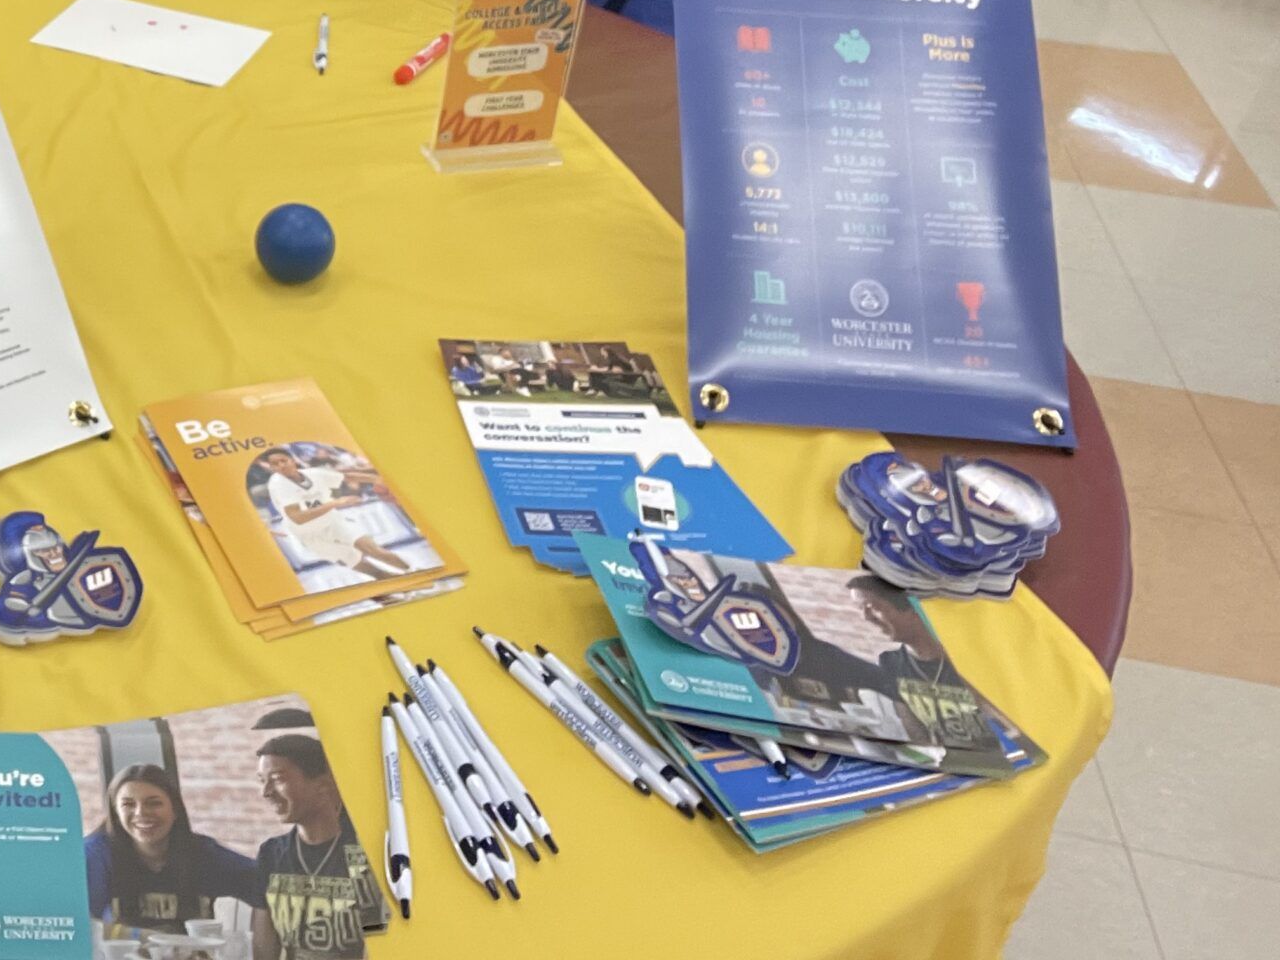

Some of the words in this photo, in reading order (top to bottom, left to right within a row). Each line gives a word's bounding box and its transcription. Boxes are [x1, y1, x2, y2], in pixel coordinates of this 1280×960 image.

[928, 49, 971, 63] More
[830, 318, 913, 335] WORCESTER
[743, 327, 801, 345] Housing
[831, 334, 913, 353] UNIVERSITY
[175, 419, 232, 445] Be
[479, 421, 521, 432] Want
[524, 424, 541, 432] to
[544, 424, 613, 434] continue
[616, 426, 642, 435] the
[483, 433, 591, 444] conversation?
[192, 436, 274, 460] active.
[2, 915, 75, 928] WORCESTER
[3, 929, 76, 941] UNIVERSITY
